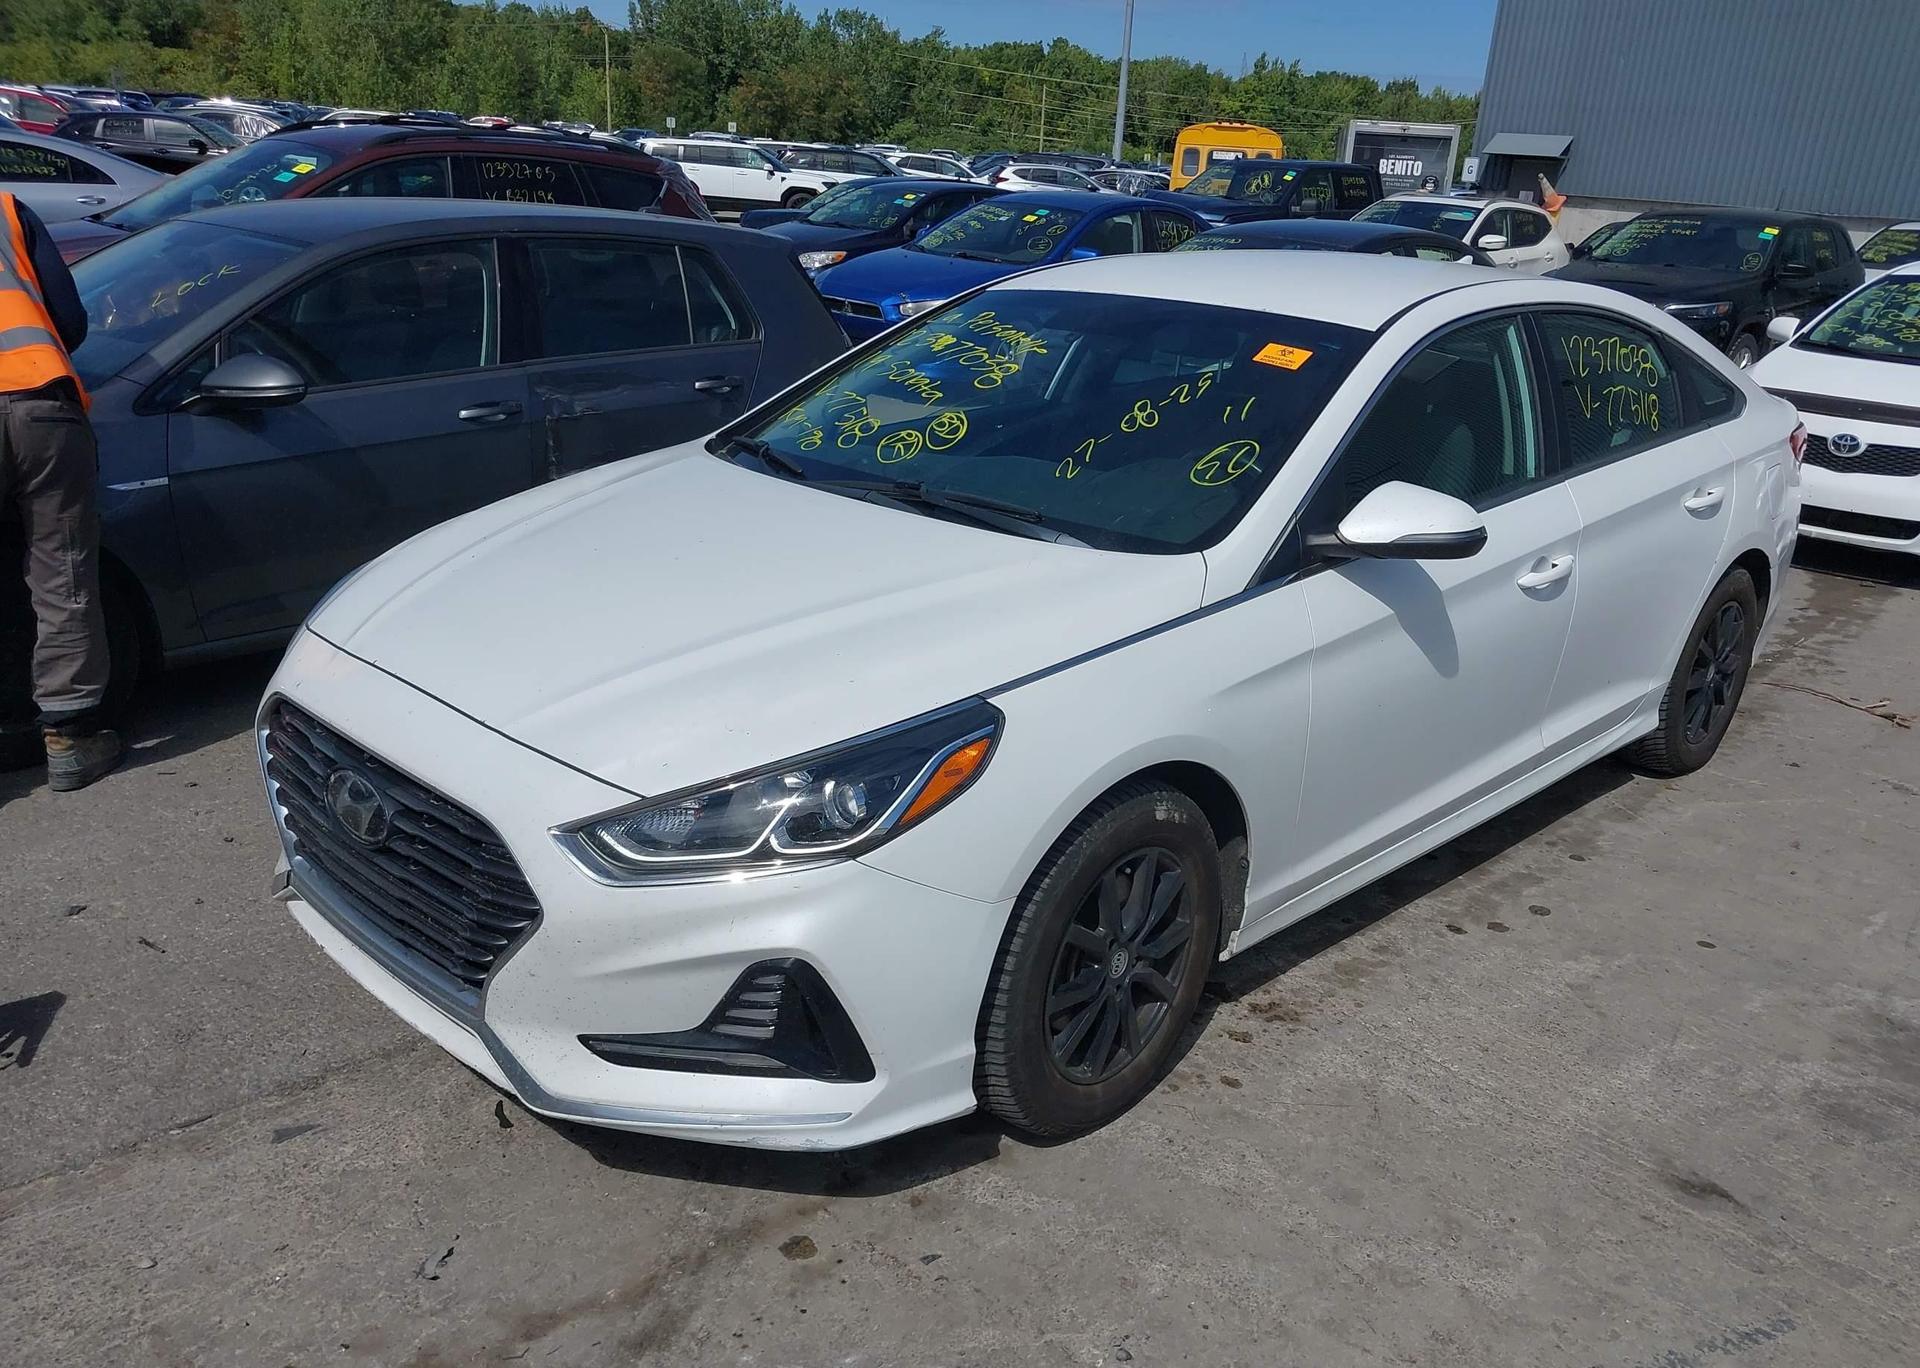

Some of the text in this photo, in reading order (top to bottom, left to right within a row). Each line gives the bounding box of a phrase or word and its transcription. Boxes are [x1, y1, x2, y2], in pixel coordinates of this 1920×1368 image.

[1379, 158, 1423, 176] BENITO
[1467, 165, 1474, 175] G
[1560, 335, 1658, 387] 12377038
[1573, 383, 1659, 431] V-775118
